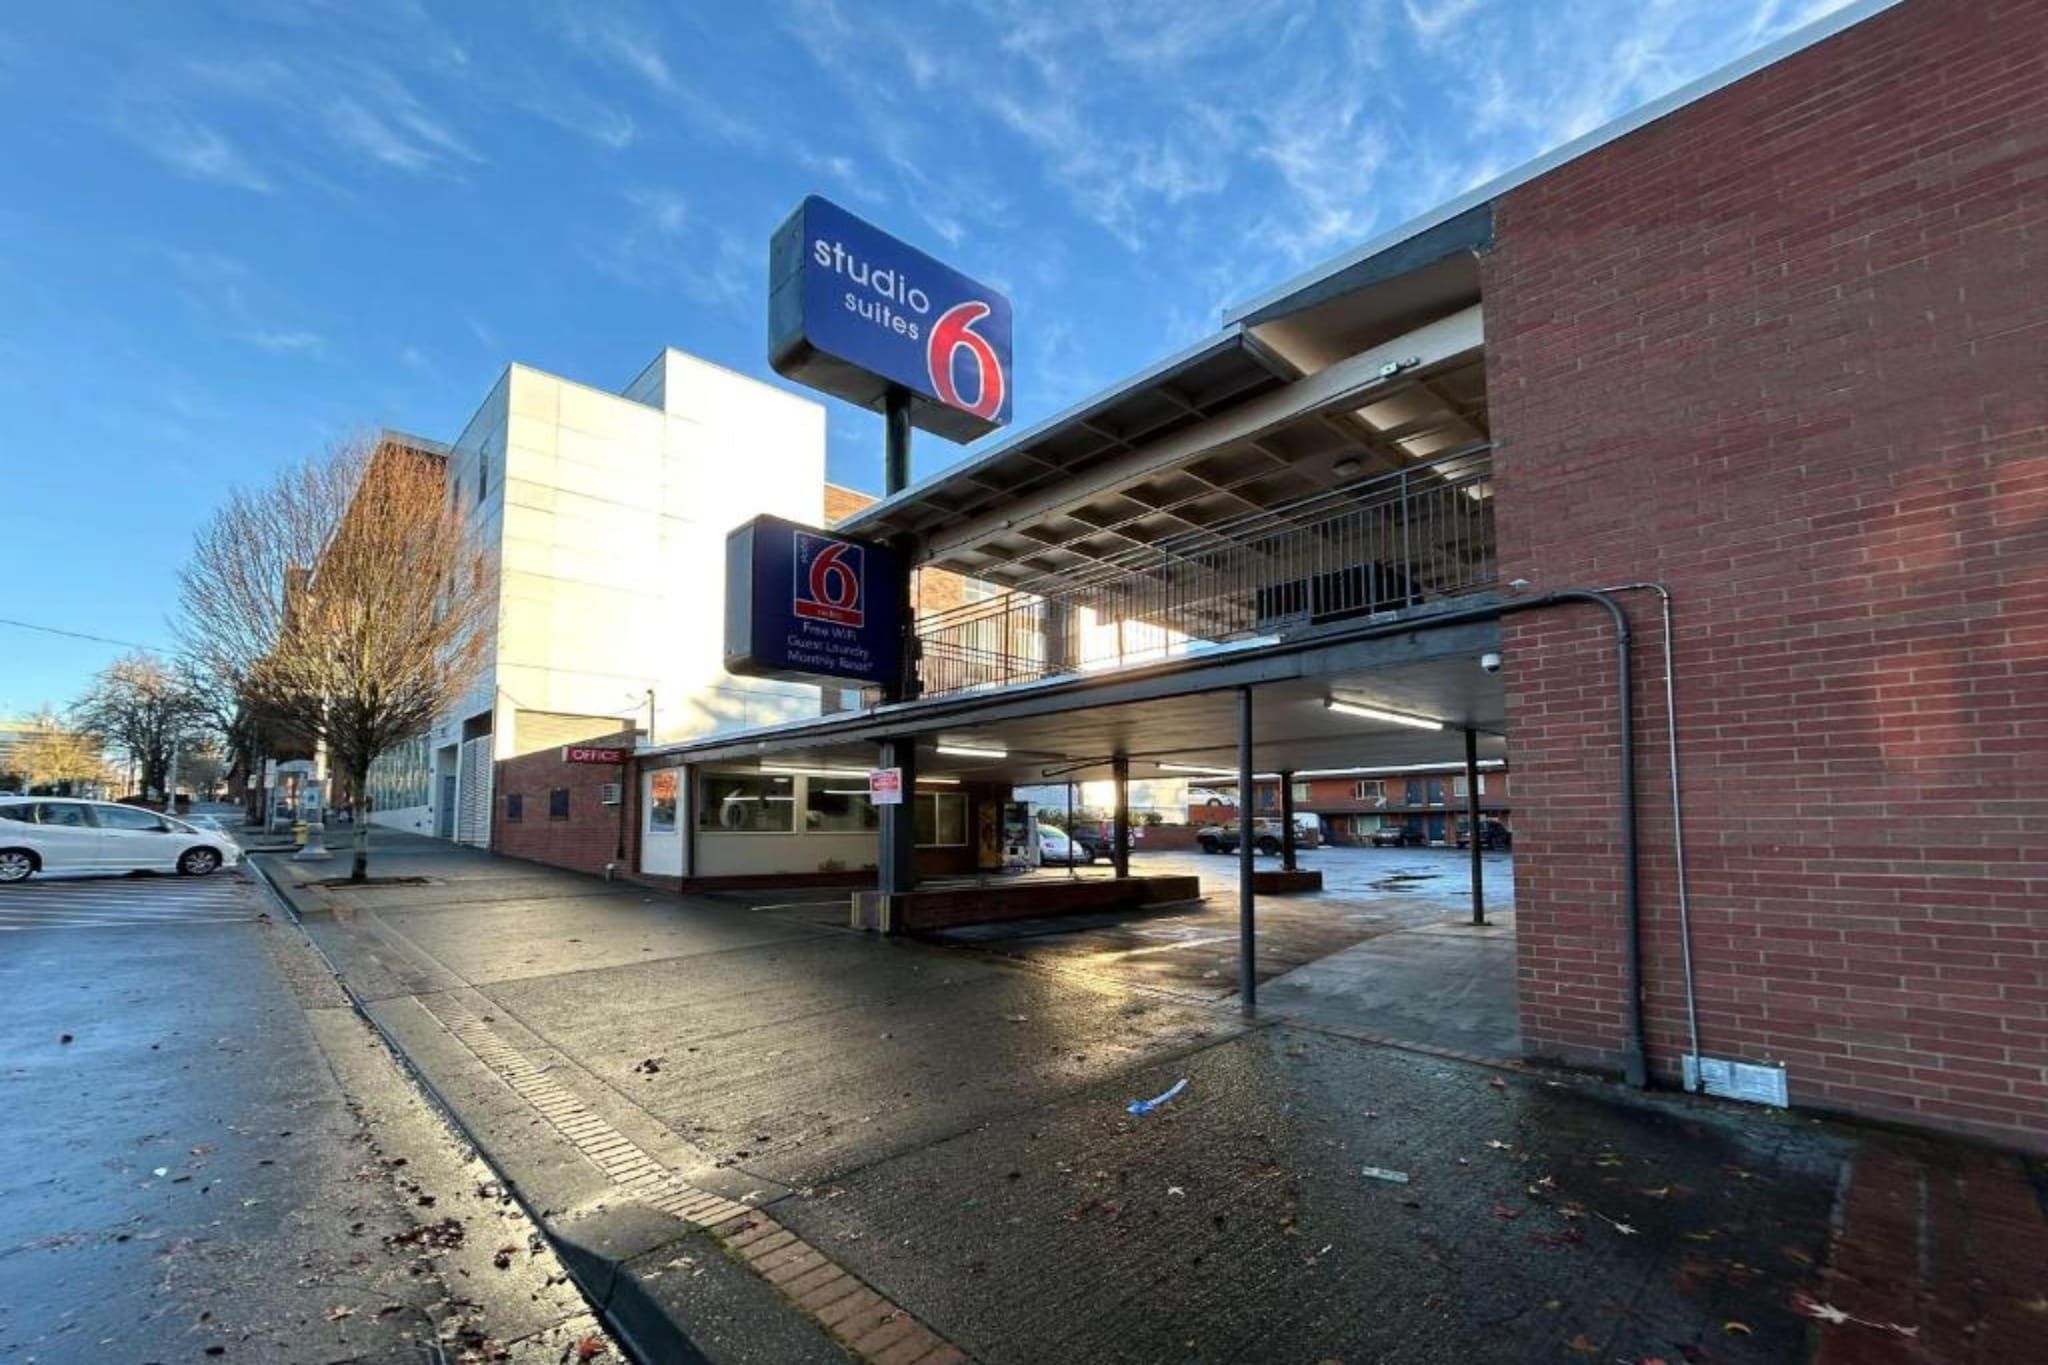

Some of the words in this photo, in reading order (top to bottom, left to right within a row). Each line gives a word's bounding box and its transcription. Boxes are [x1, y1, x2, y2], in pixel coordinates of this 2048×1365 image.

[814, 239, 930, 315] studio
[845, 292, 920, 340] suites
[927, 301, 1005, 421] 6
[809, 543, 859, 609] 6
[787, 634, 824, 650] Guest
[803, 621, 829, 637] Free
[787, 649, 836, 669] Monthly
[572, 749, 621, 761] OFFICE
